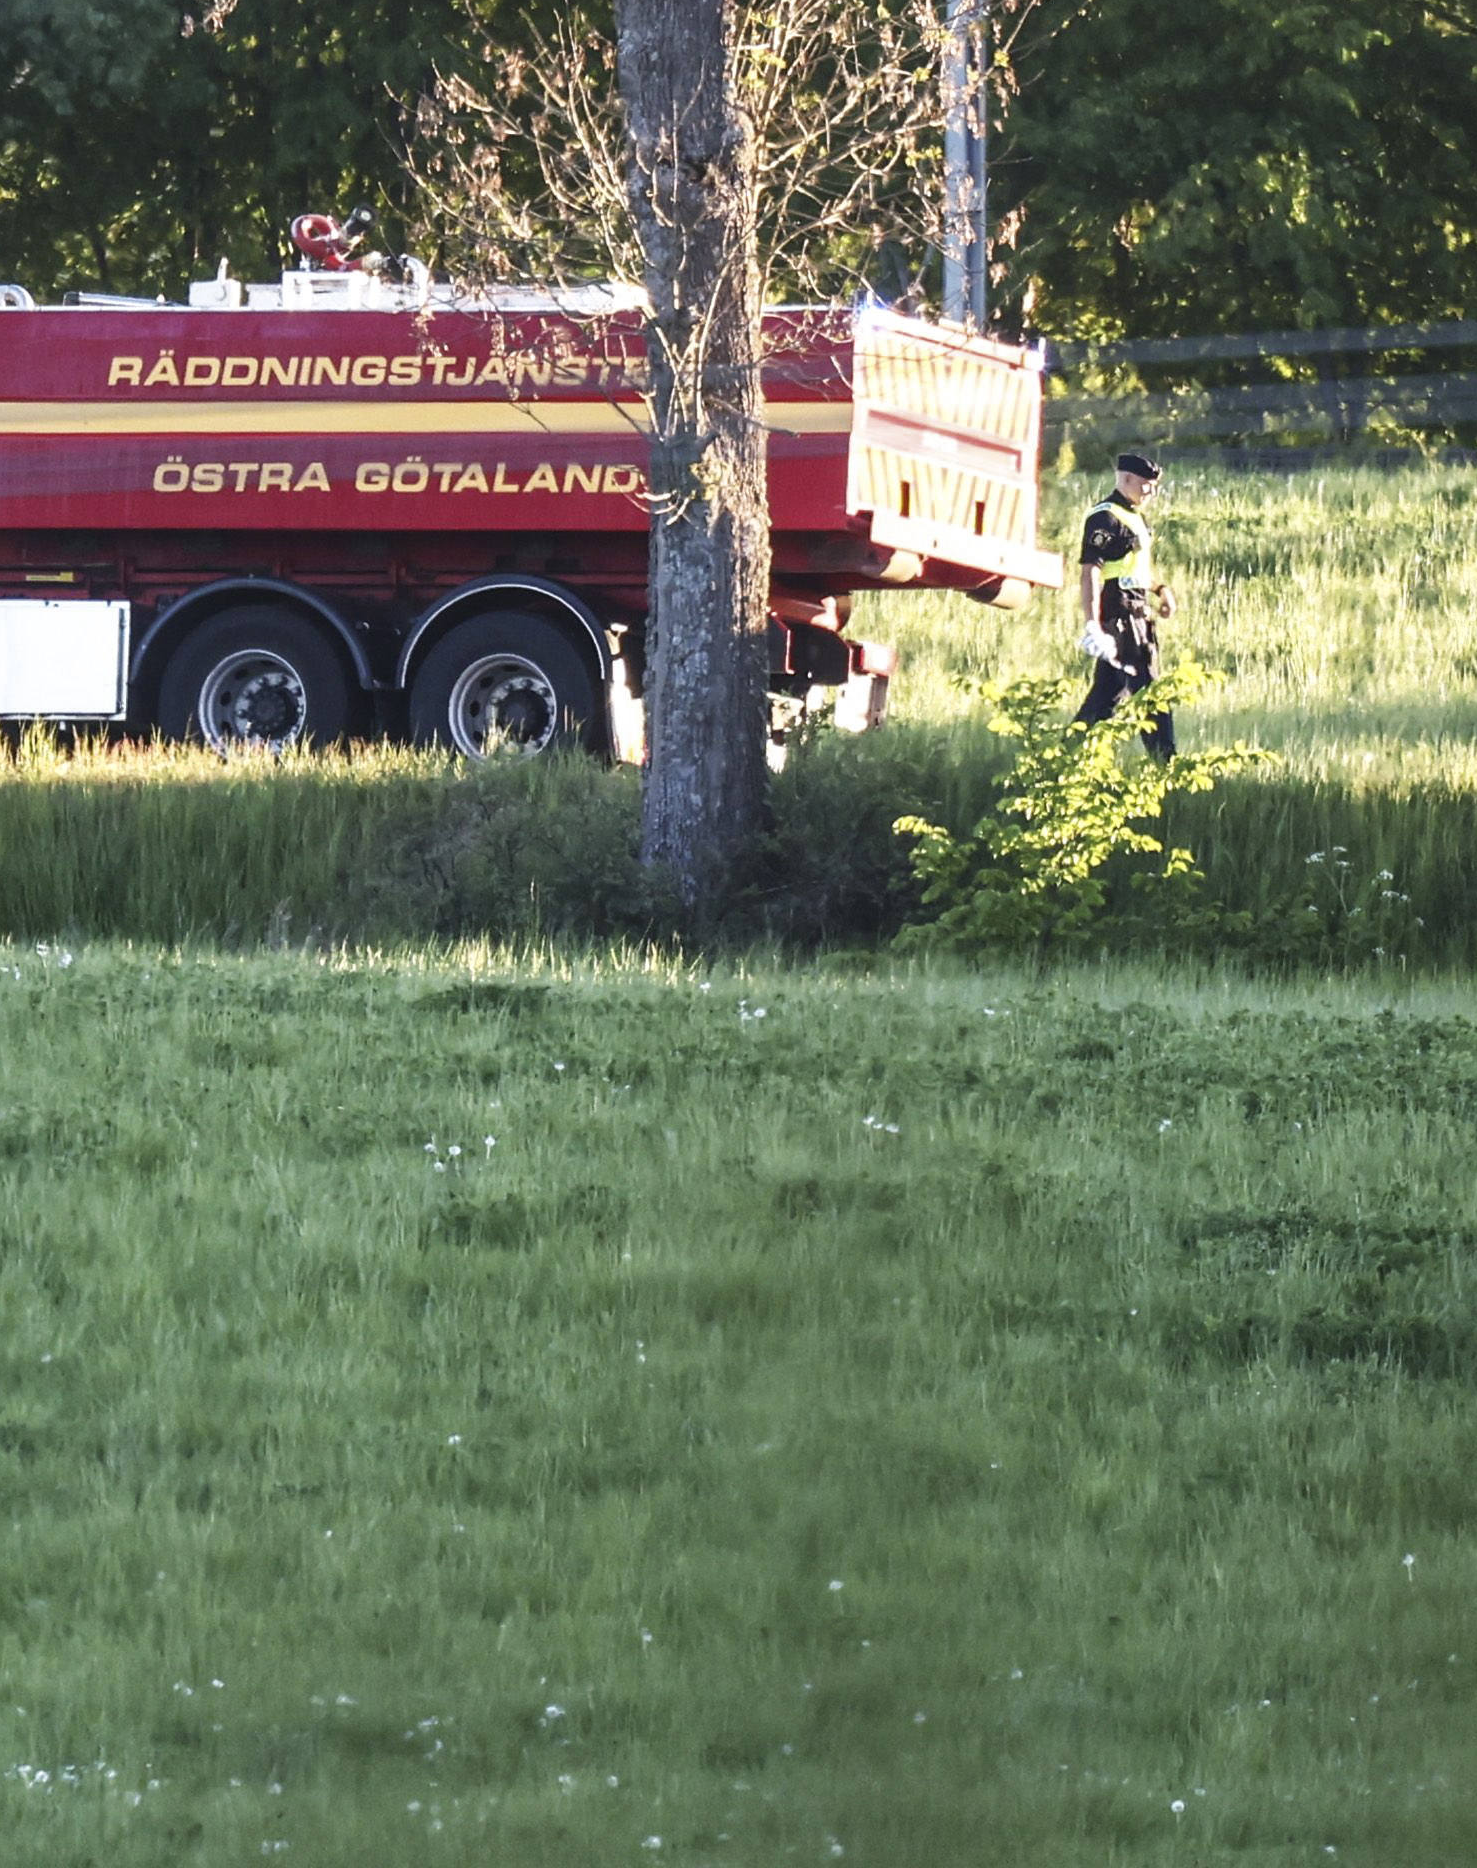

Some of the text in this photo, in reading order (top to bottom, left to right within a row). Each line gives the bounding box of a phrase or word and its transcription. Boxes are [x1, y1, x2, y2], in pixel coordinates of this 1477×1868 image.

[107, 349, 651, 387] RÄDDNINGSTJÄNSTE
[152, 455, 640, 493] ÖSTRA GÖTALAND
